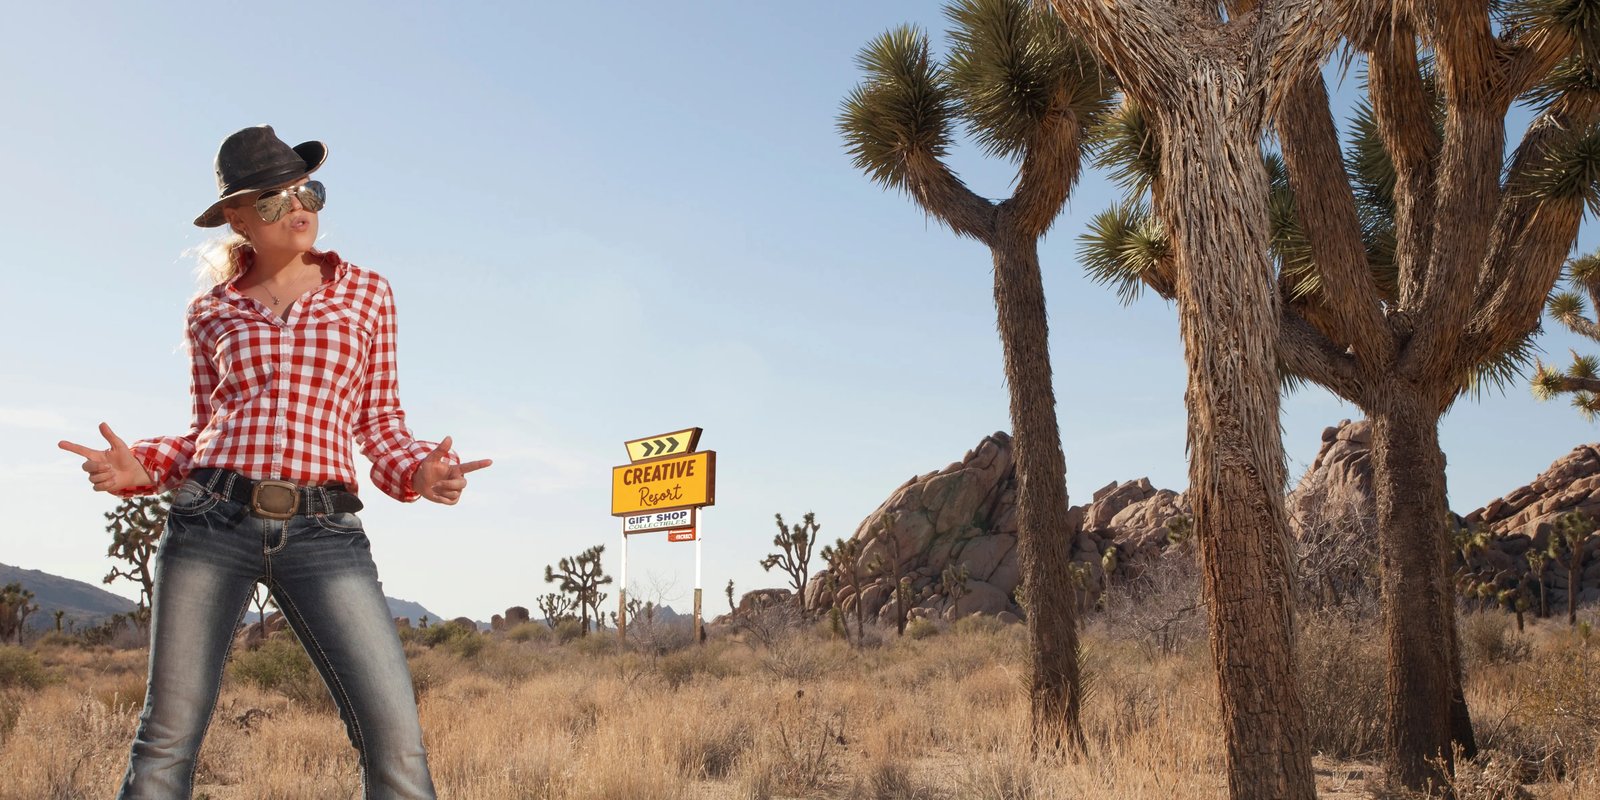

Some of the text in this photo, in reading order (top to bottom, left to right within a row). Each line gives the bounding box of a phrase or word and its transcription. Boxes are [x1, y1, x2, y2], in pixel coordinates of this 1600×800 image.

[624, 459, 696, 486] CREATIVE
[639, 484, 683, 507] Resort
[628, 511, 687, 525] GIFT SHOP
